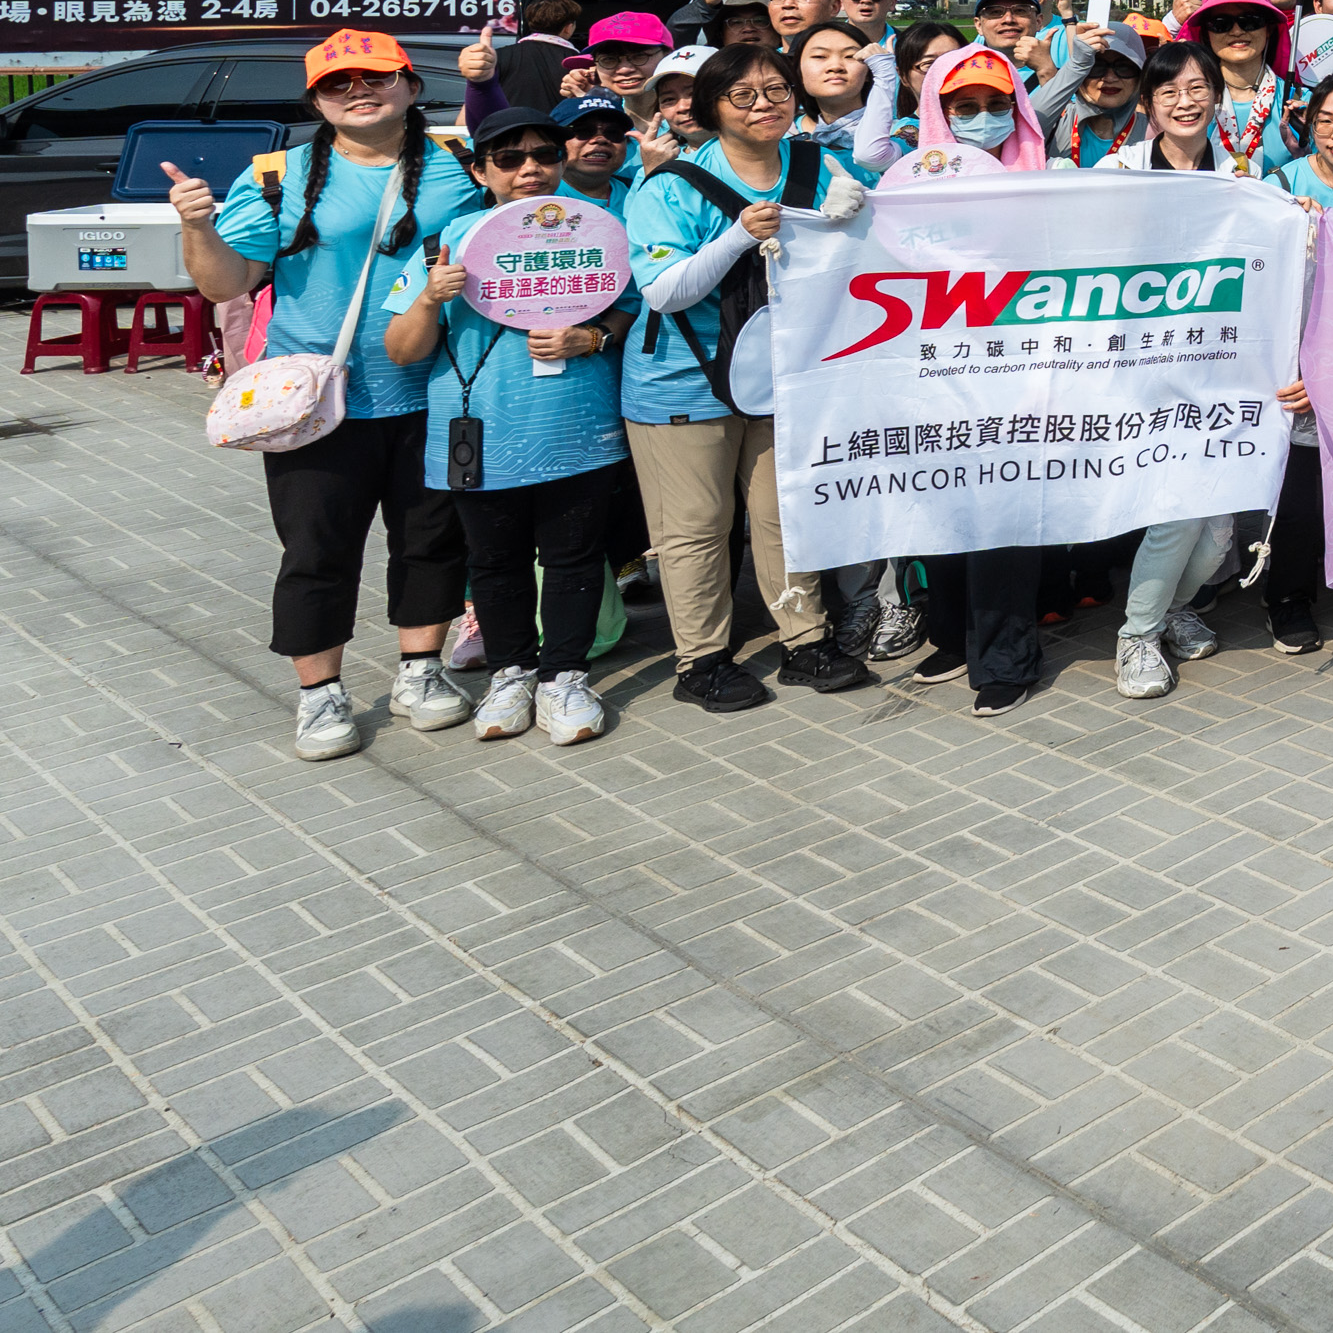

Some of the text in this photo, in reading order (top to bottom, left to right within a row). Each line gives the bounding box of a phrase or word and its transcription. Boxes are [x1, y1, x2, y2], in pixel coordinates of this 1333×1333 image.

[79, 231, 125, 241] IGLOO
[496, 248, 603, 273] 守護環境
[480, 272, 616, 300] 走最溫柔的進香路
[919, 349, 1237, 378] Devoted to carbon neutrality and new materials innovation
[811, 400, 1264, 468] 上緯國際投資控股股份有限公司
[814, 439, 1266, 506] SWANCOR HOLDING CO., LTD.
